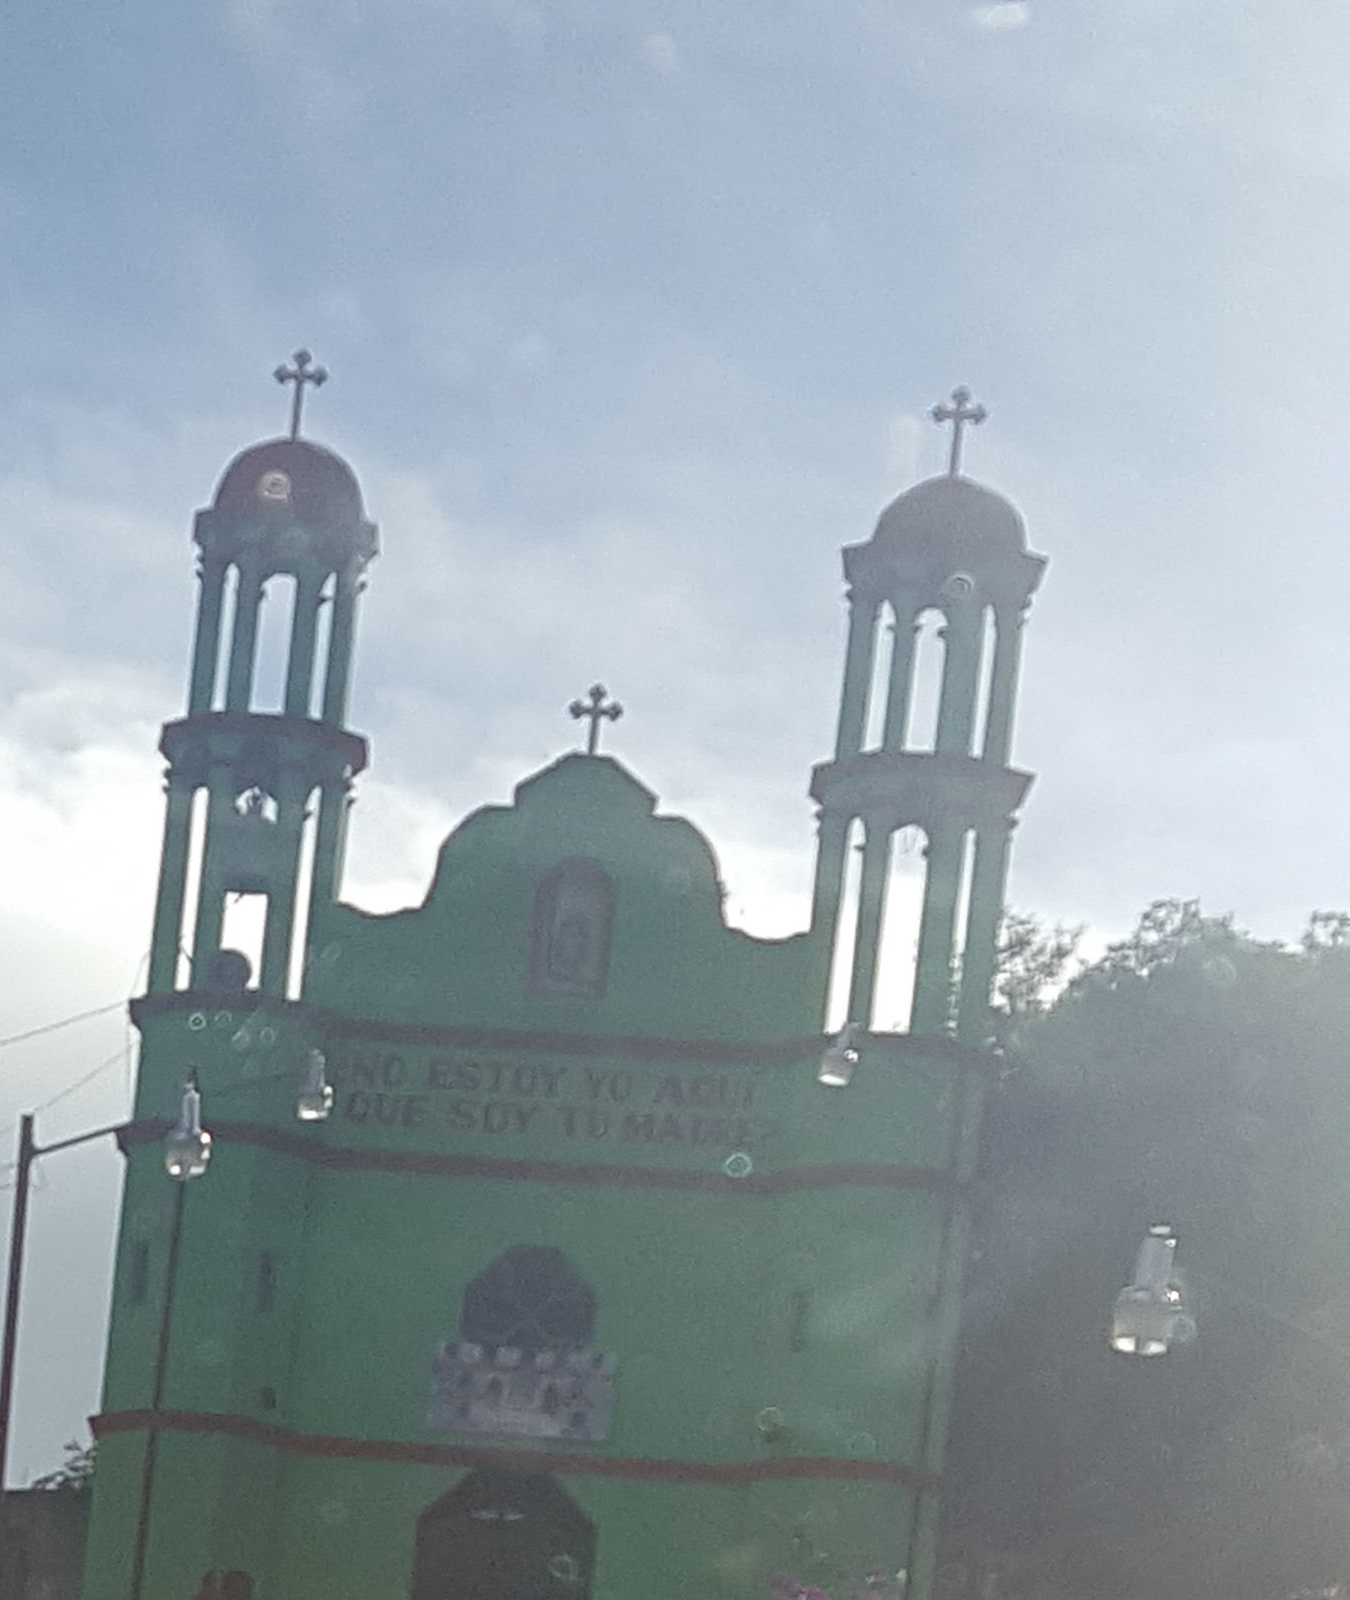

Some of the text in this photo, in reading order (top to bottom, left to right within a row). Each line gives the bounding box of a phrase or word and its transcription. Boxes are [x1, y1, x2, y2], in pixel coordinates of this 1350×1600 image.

[429, 1057, 568, 1098] ESTOY
[585, 1067, 633, 1101] YO
[343, 1091, 424, 1127] QUE
[448, 1099, 539, 1135] SOY
[556, 1105, 609, 1141] TU
